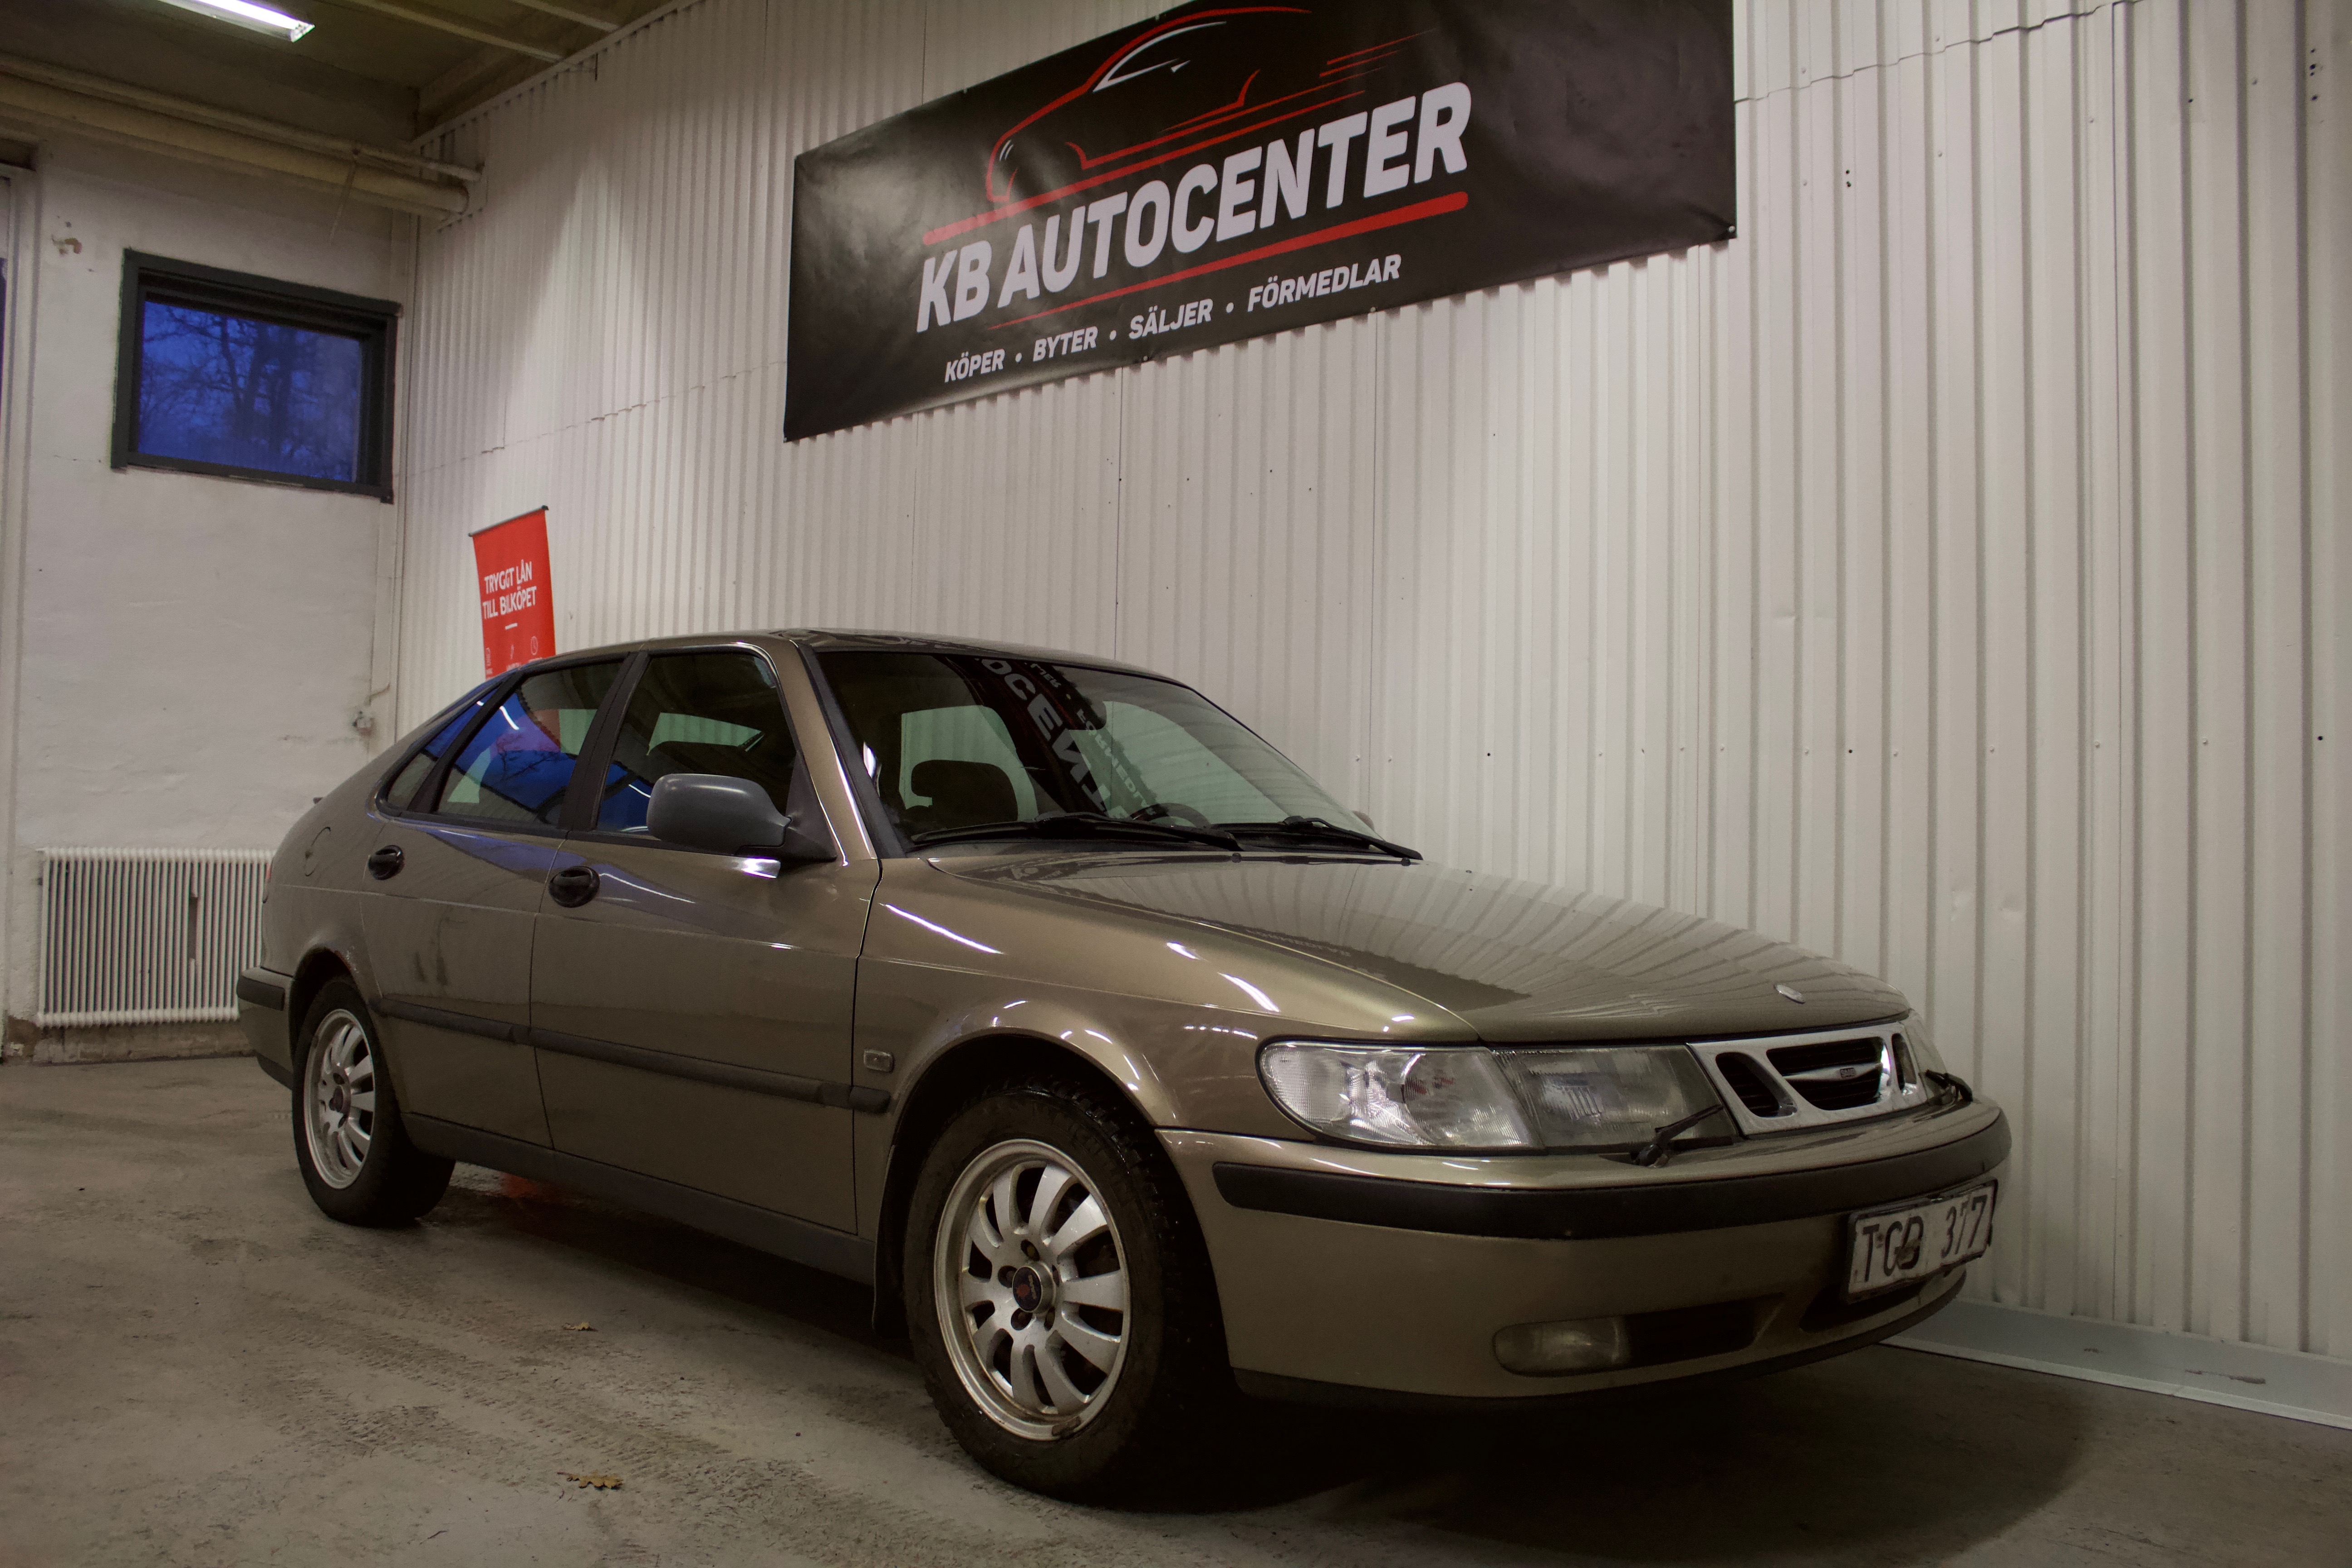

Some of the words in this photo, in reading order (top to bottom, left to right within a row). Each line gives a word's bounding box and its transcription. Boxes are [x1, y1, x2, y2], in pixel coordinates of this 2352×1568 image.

[917, 240, 992, 333] KB
[997, 82, 1471, 309] AUTOCENTER
[945, 348, 1006, 382] KÖPER
[1033, 326, 1098, 362] BYTER
[1129, 299, 1214, 339] SÄLJER
[1248, 255, 1401, 312] FÖRMEDLAR
[482, 600, 499, 620] TILL
[500, 583, 537, 616] BILKÖPET
[484, 567, 514, 594] TRYGGT
[515, 559, 532, 585] LÅN
[1941, 1194, 1988, 1259] 377
